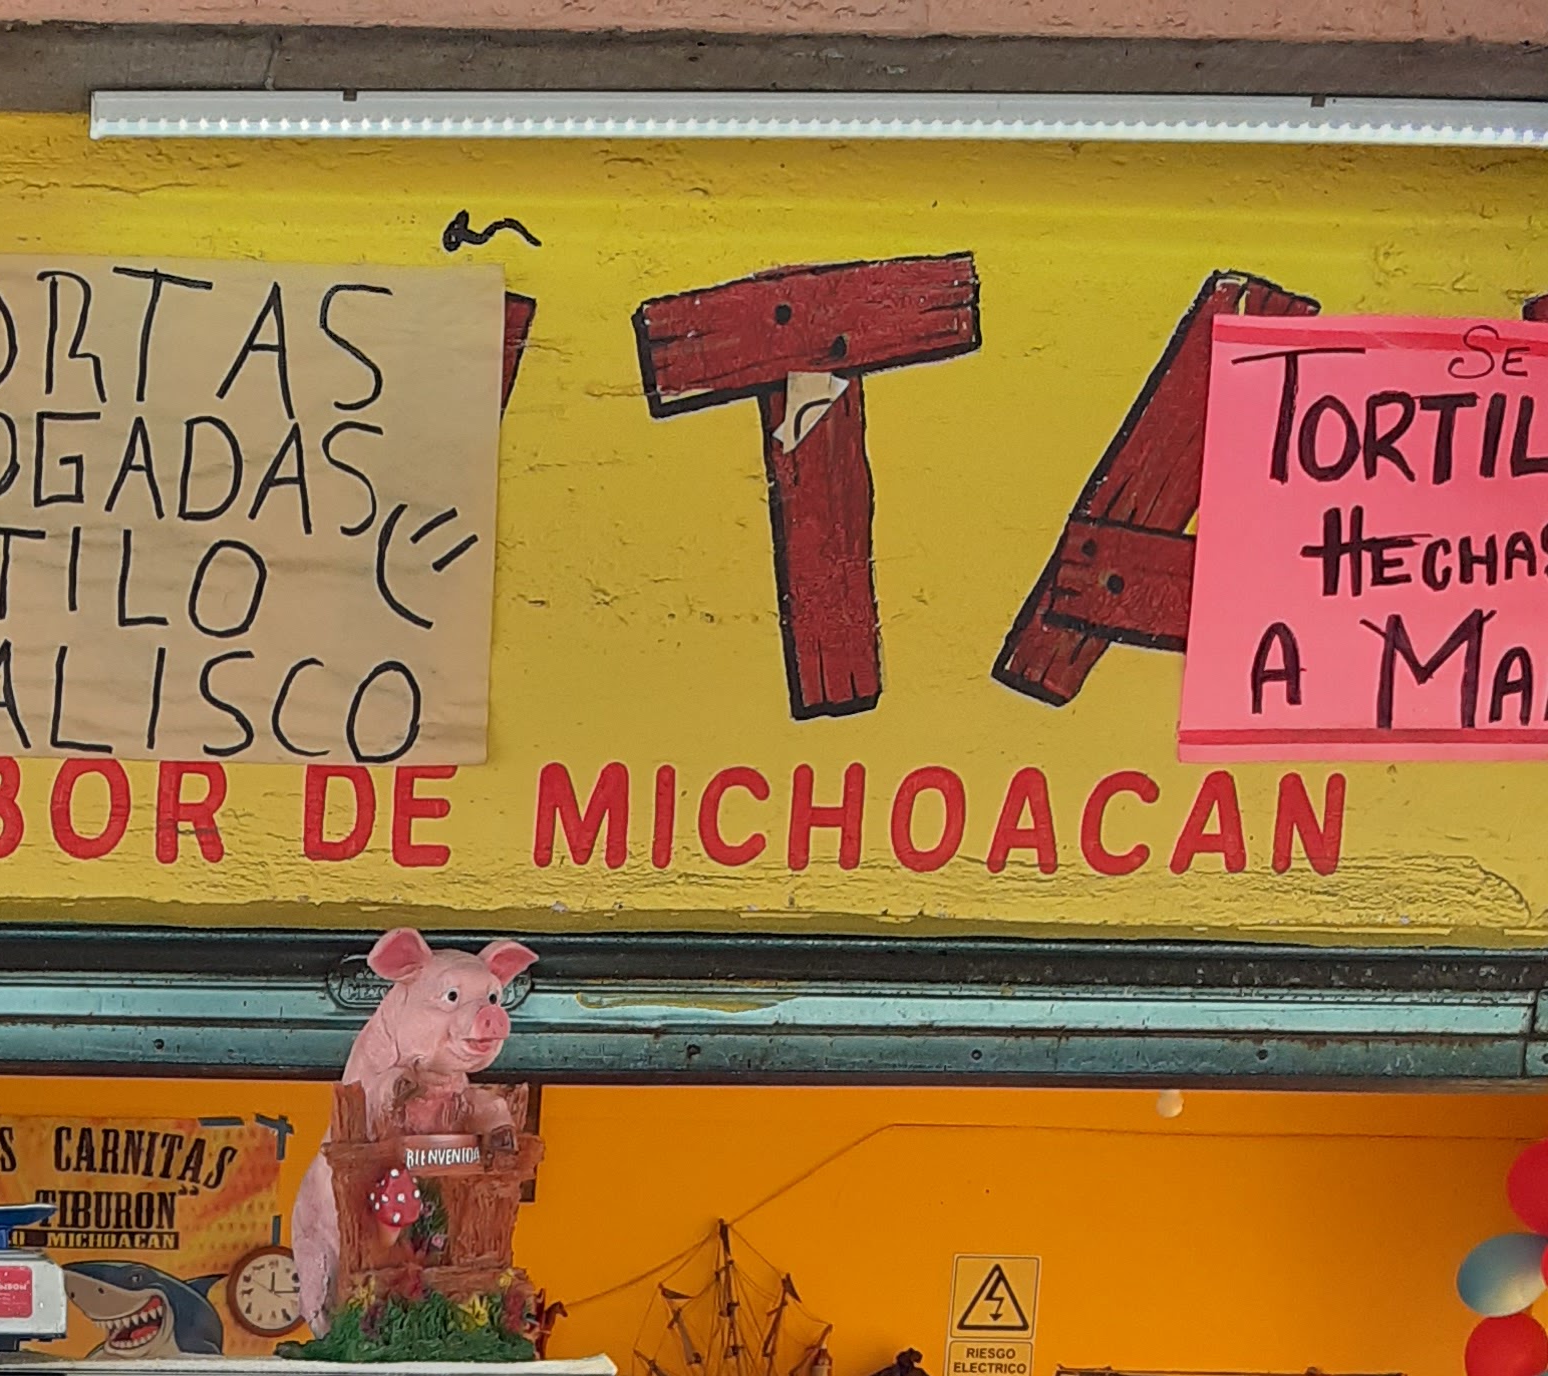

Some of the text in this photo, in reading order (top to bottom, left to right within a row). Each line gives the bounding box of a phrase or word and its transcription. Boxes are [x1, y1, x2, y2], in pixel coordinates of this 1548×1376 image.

[1448, 324, 1531, 379] SE
[1251, 608, 1548, 730] A MA
[303, 763, 458, 869] DE
[533, 761, 1346, 876] MICHOACAN
[54, 1126, 236, 1190] CARNITAS
[47, 1231, 177, 1249] MICHOACAN
[953, 1362, 1027, 1375] ELECTRICO
[966, 1347, 1016, 1360] RIESGO
